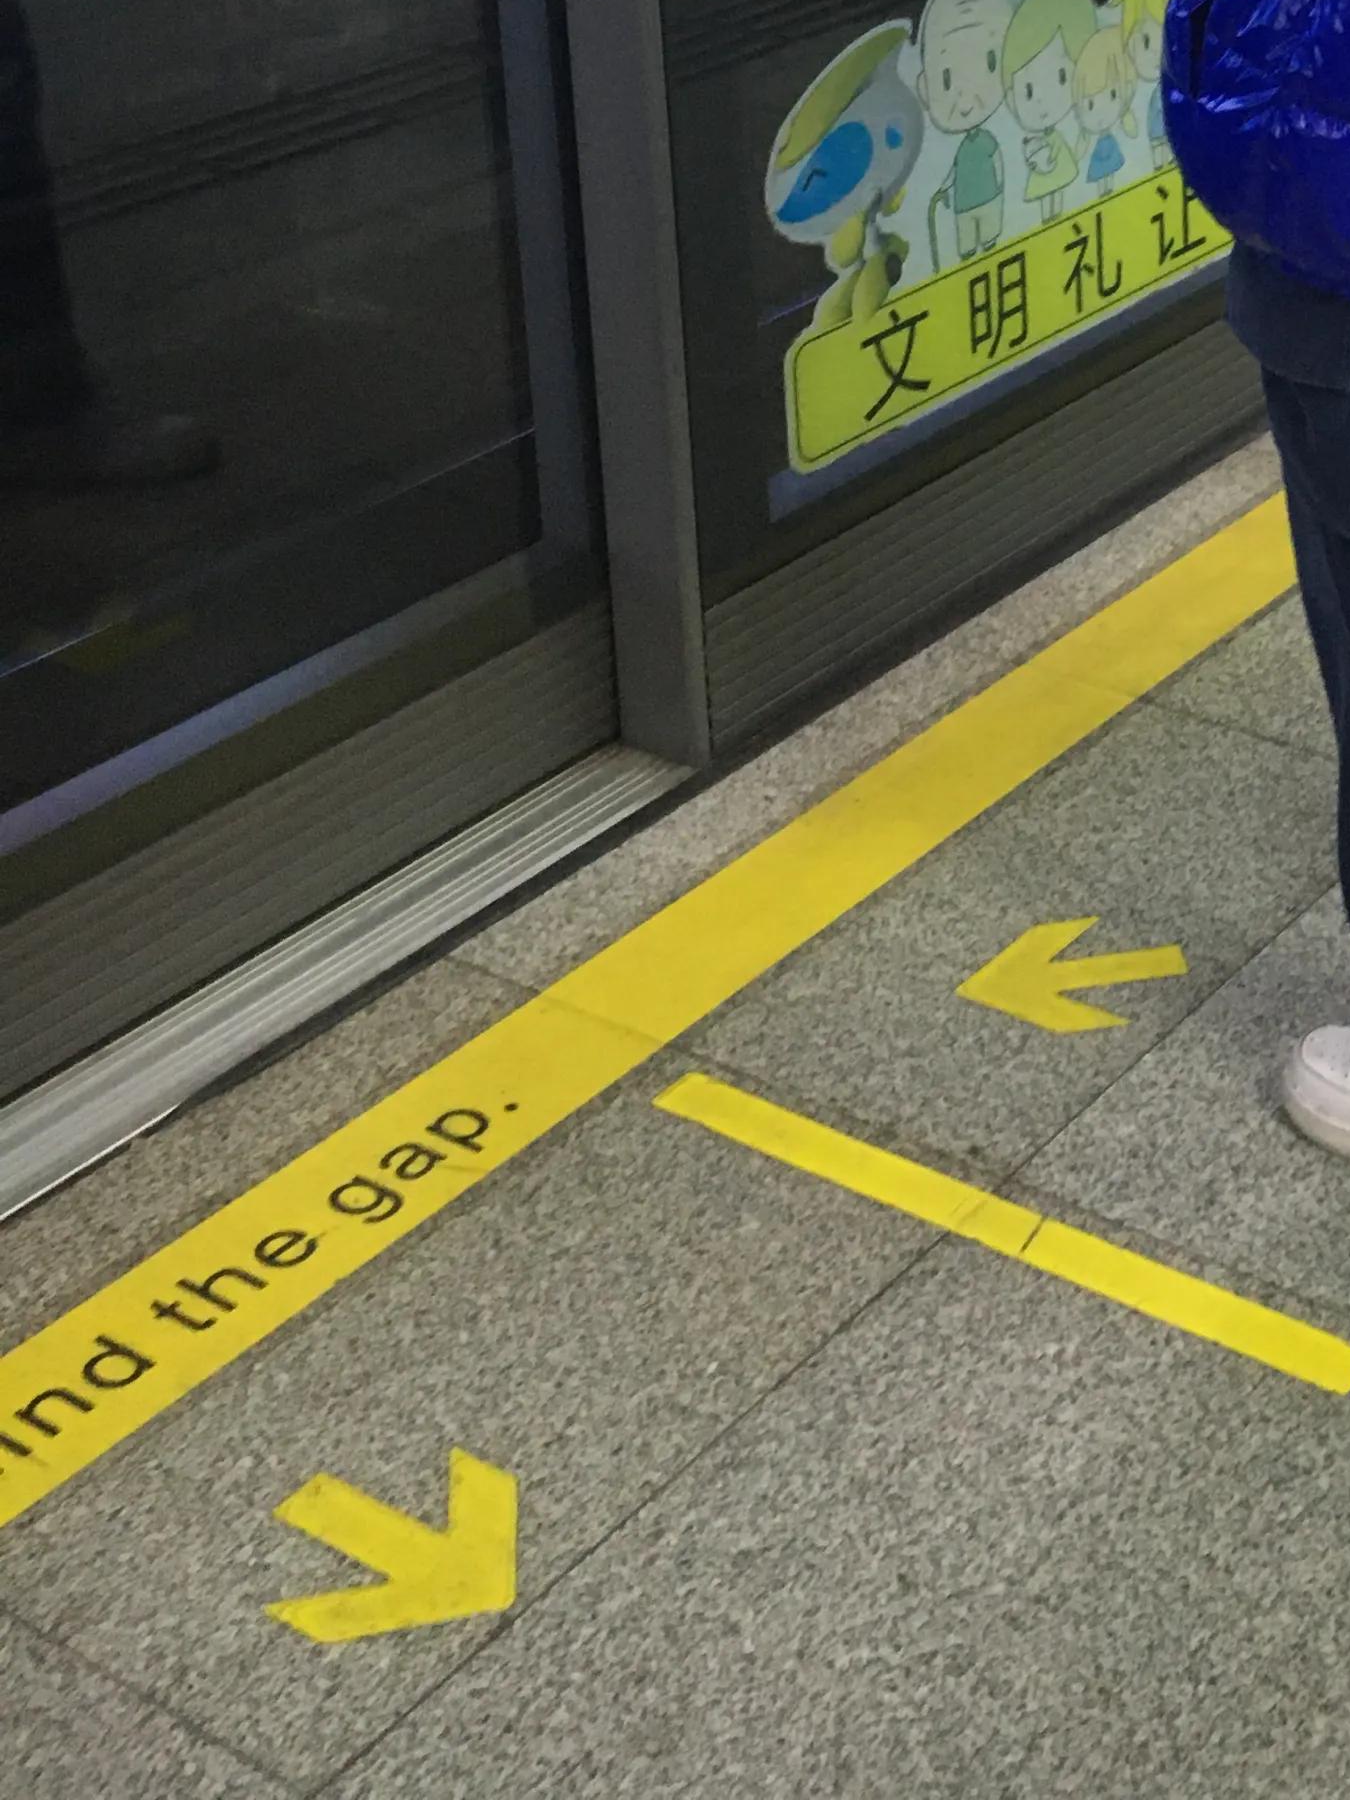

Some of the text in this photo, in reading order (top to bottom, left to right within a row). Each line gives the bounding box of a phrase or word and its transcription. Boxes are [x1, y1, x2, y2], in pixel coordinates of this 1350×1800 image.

[860, 184, 1208, 422] 文明礼让
[0, 1100, 520, 1476] ind the gap.
